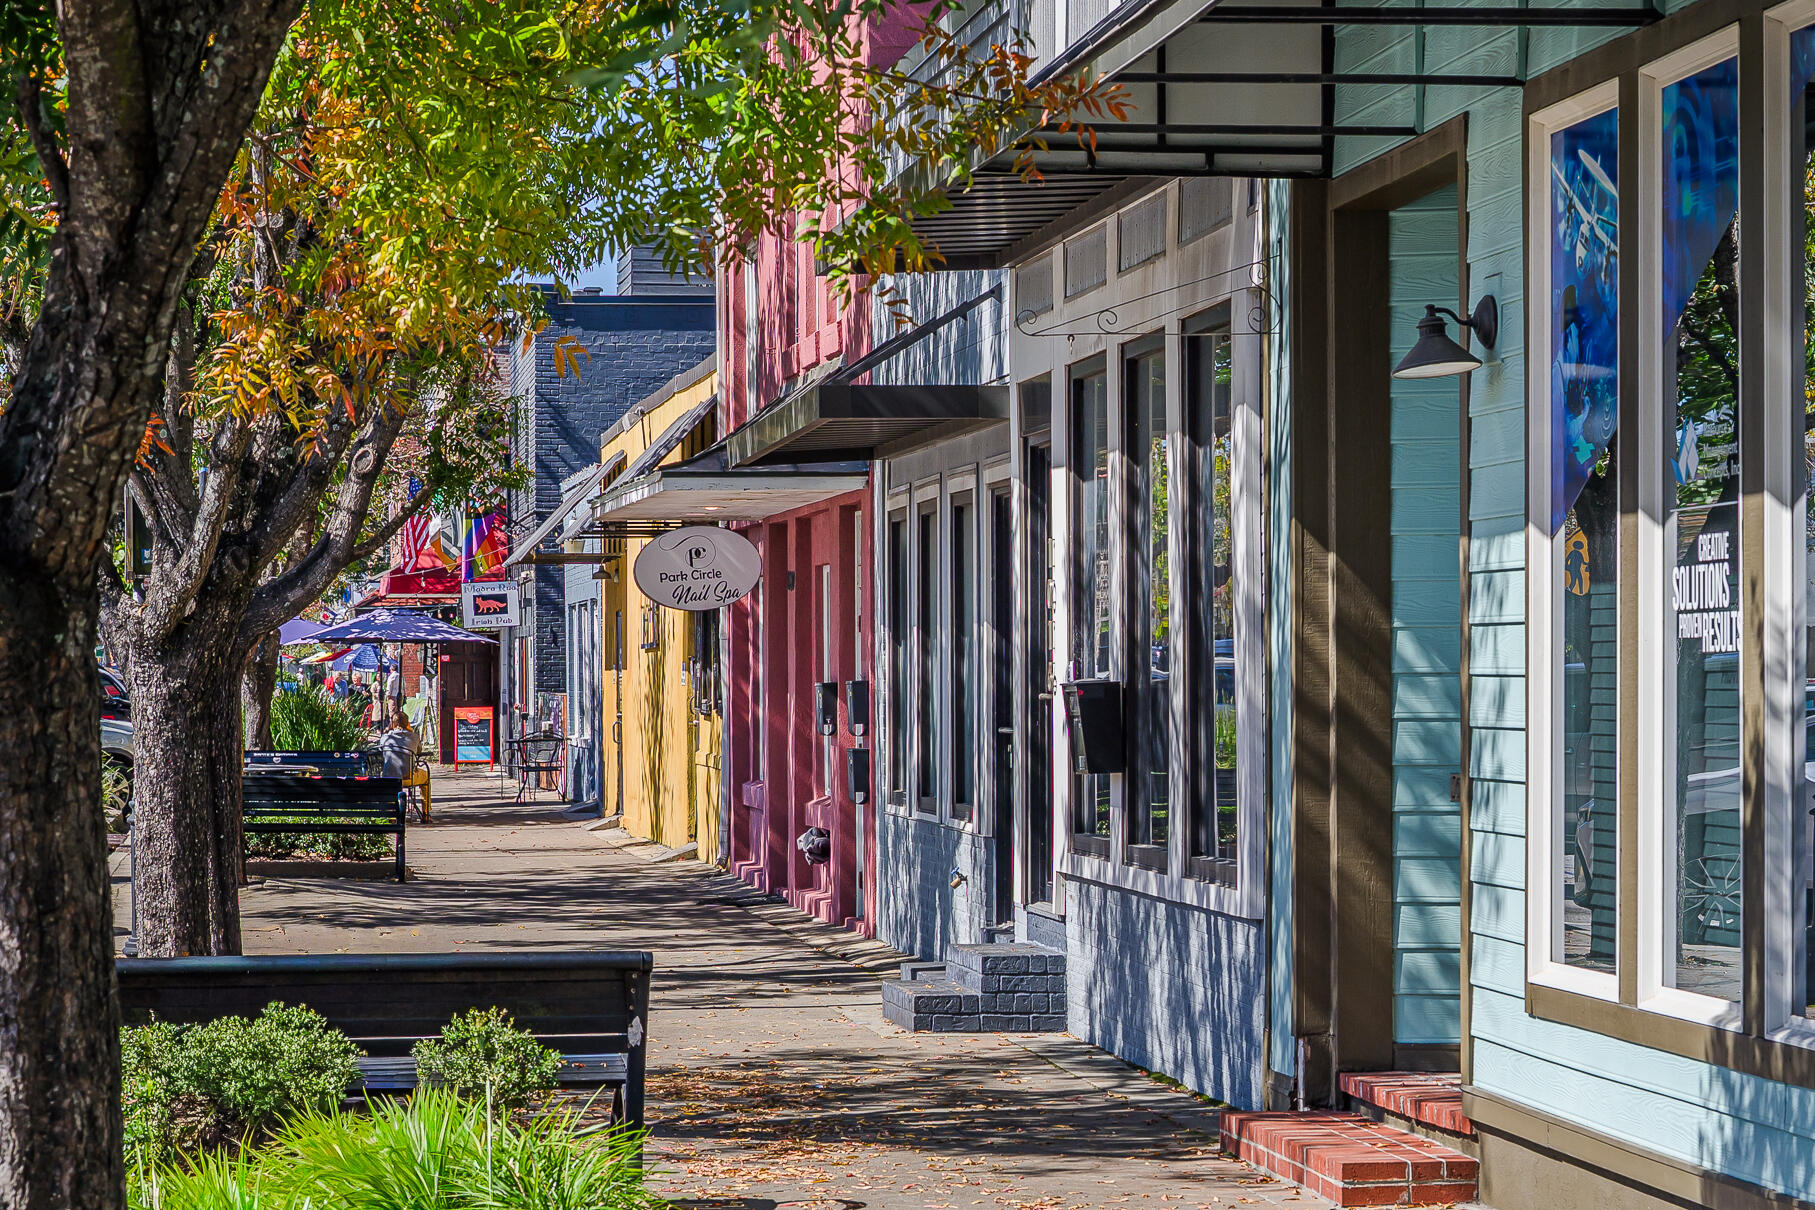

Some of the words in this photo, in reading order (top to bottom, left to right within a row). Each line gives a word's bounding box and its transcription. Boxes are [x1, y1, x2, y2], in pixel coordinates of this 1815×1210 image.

[1698, 532, 1729, 561] CREATIVE
[660, 571, 688, 583] Park
[691, 568, 722, 580] Circle
[1672, 563, 1730, 611] SOLUTIONS
[672, 584, 711, 604] Nail
[714, 581, 742, 603] Spa
[1678, 612, 1702, 638] PROVEN
[1702, 610, 1741, 653] RESULTS
